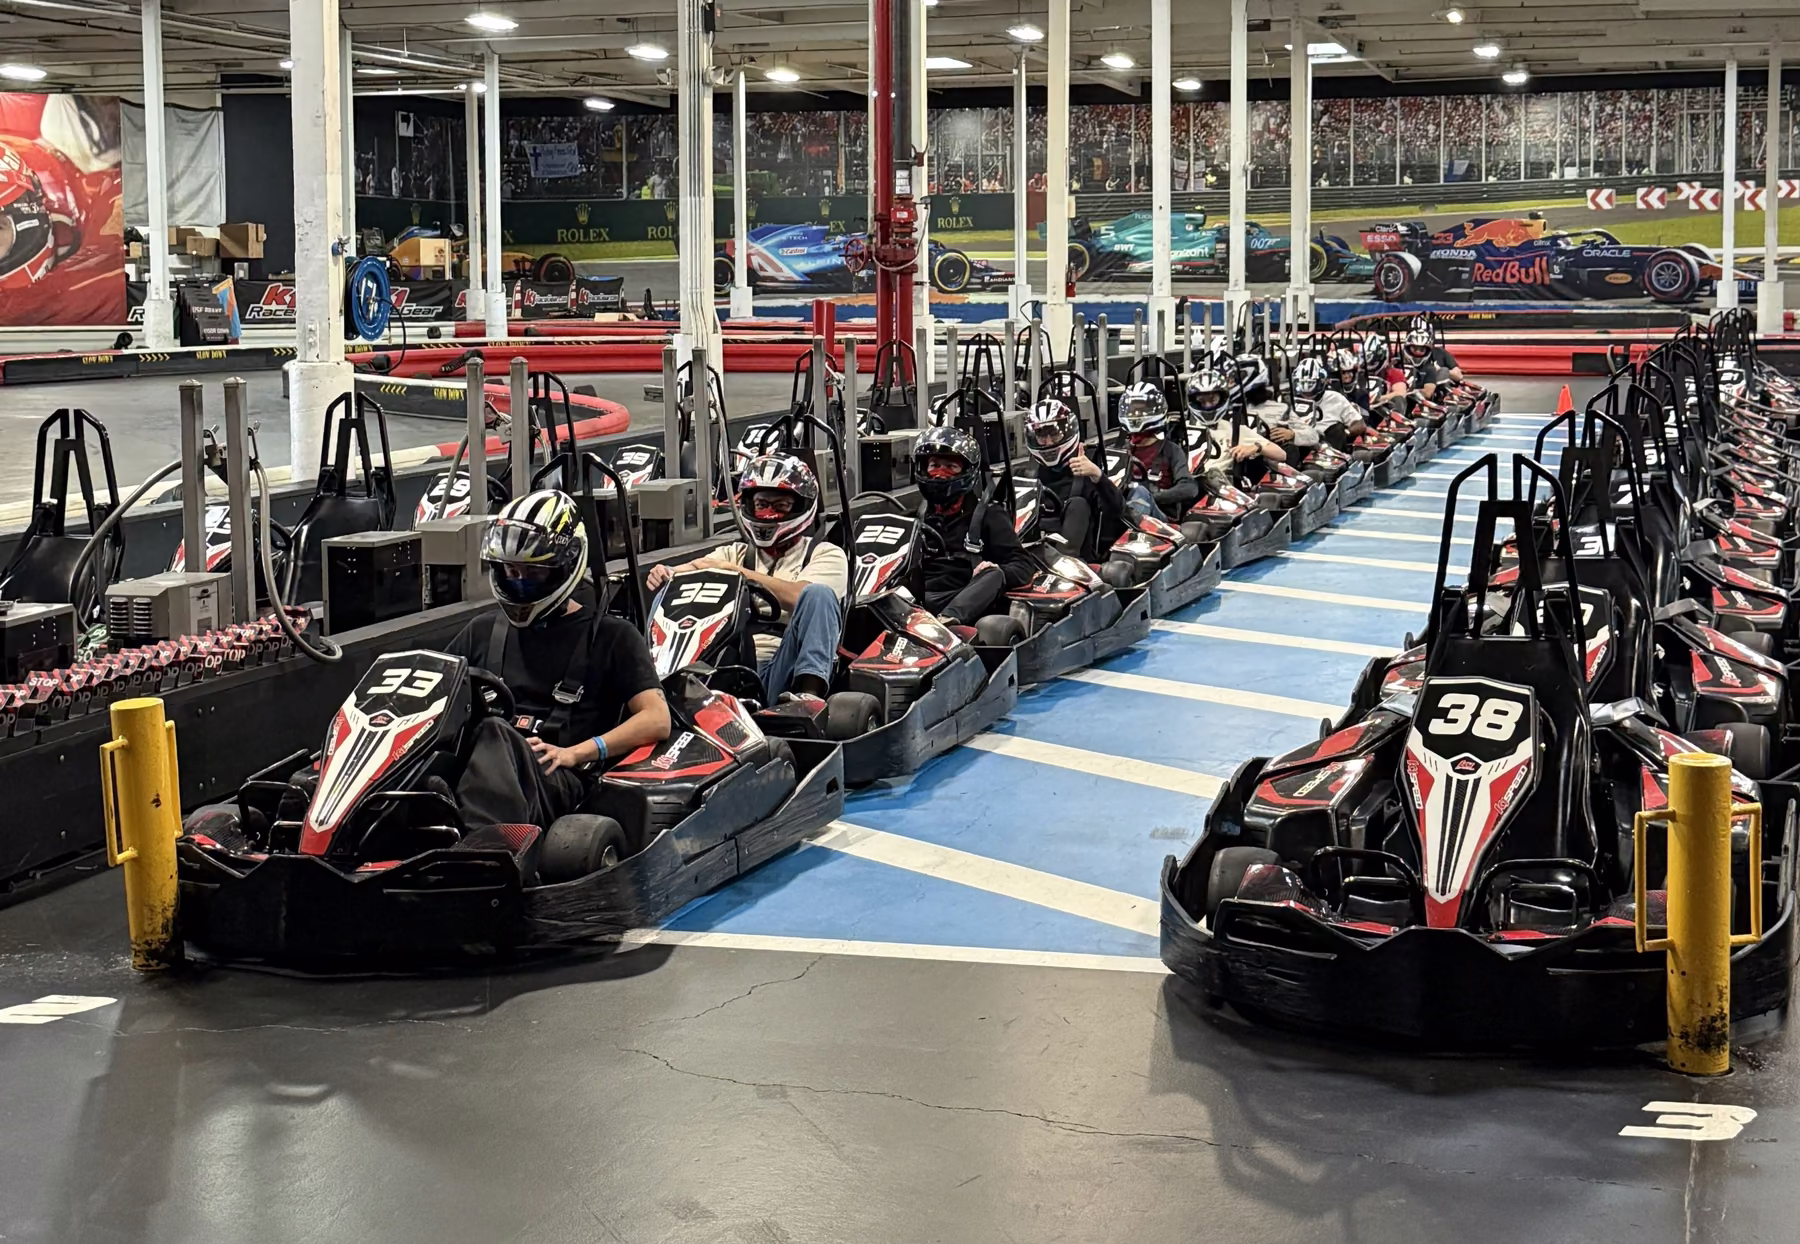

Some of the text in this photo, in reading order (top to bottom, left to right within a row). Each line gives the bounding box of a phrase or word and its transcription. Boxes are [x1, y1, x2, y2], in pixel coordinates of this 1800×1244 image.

[938, 216, 974, 229] ROLEX
[557, 228, 610, 242] ROLEX
[647, 225, 674, 239] ROL
[1100, 225, 1116, 239] 5
[1113, 243, 1135, 251] BWT
[1250, 238, 1281, 249] 007
[785, 247, 806, 255] Castrol
[1171, 246, 1209, 257] nizant
[1431, 248, 1477, 257] HONDA
[1582, 249, 1631, 258] ORACLE
[795, 256, 847, 270] ALPIN
[245, 303, 296, 319] Race
[616, 452, 650, 465] 39
[429, 478, 471, 497] 29
[855, 525, 906, 545] 22
[670, 582, 729, 606] 32
[205, 655, 223, 669] OP
[224, 648, 246, 662] TOP
[29, 677, 59, 687] STOP
[143, 671, 162, 682] OP
[366, 668, 444, 698] 33
[1428, 692, 1524, 742] 38
[1618, 1101, 1758, 1141] 3
